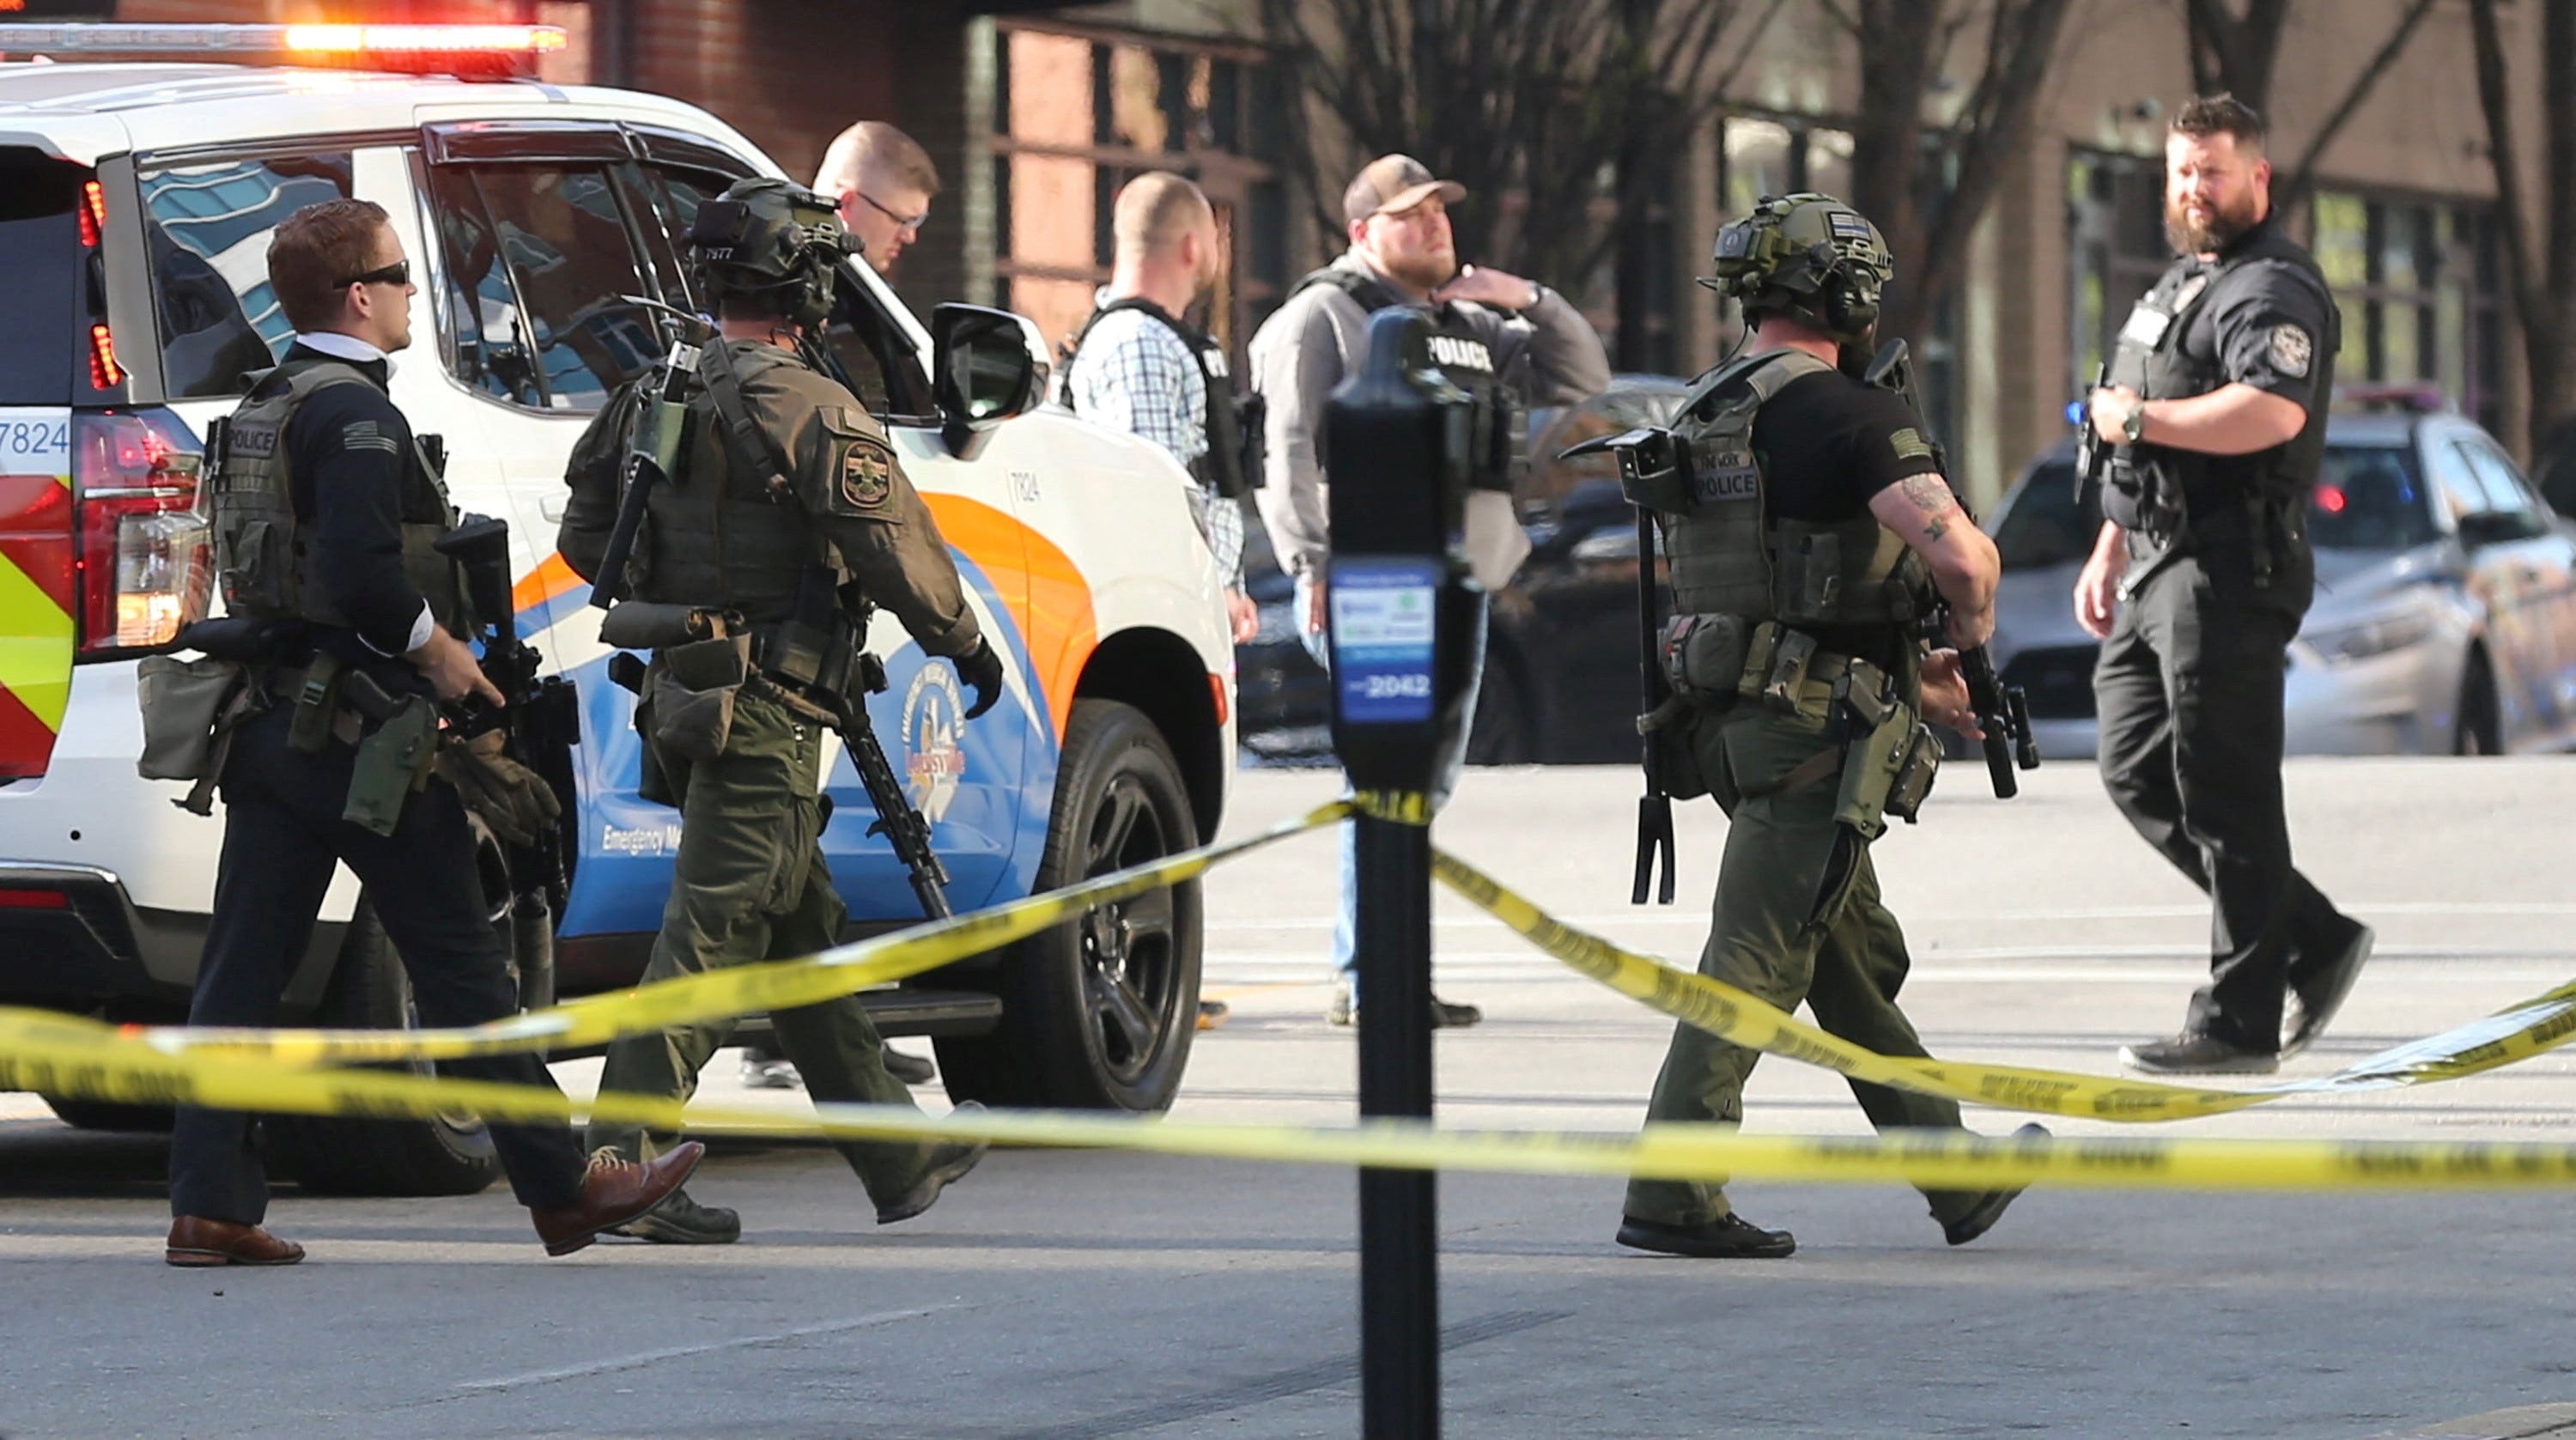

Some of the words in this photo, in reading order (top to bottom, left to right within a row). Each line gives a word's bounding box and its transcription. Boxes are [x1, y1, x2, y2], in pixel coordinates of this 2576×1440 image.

[1425, 336, 1494, 373] POLICE
[0, 422, 70, 454] 7824
[227, 428, 275, 452] POLICE
[1697, 473, 1754, 496] POLICE
[603, 823, 662, 857] Emergency
